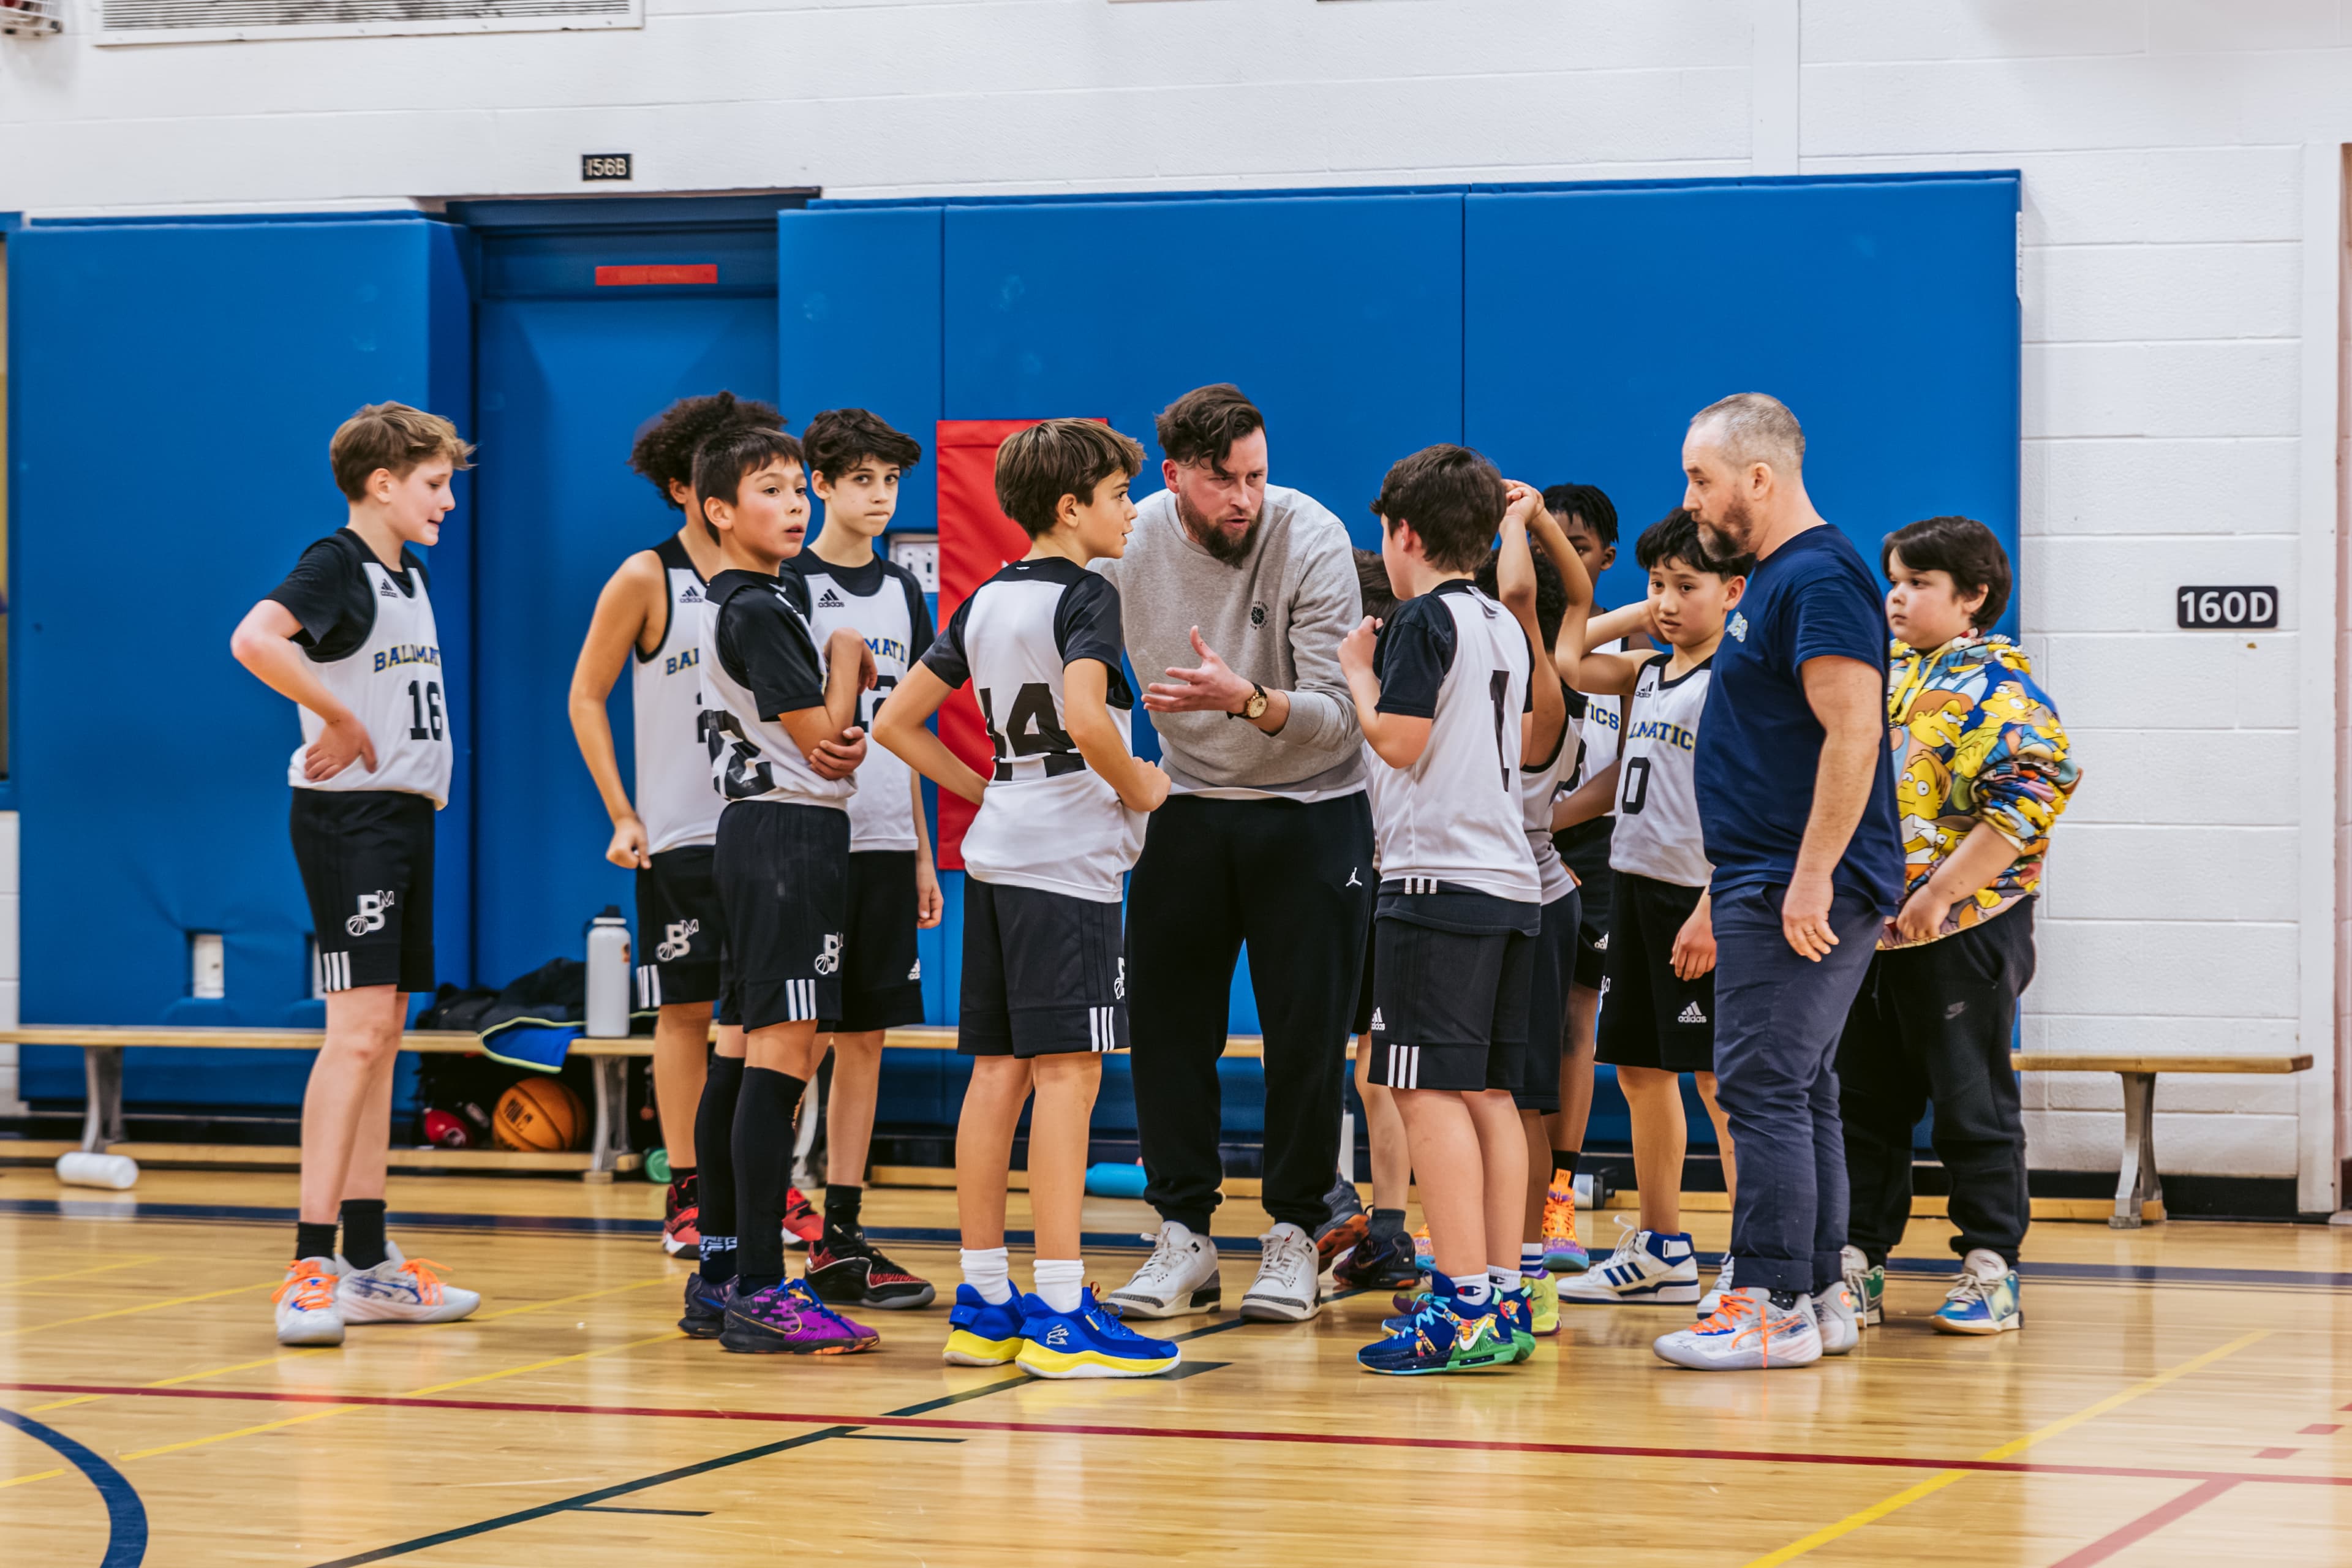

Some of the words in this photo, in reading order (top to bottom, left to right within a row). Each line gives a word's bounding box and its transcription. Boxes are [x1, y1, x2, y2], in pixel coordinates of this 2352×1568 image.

[2181, 591, 2273, 623] 160D
[409, 680, 443, 741] 16
[1622, 756, 1651, 815] 0
[1678, 1014, 1707, 1023] adidas
